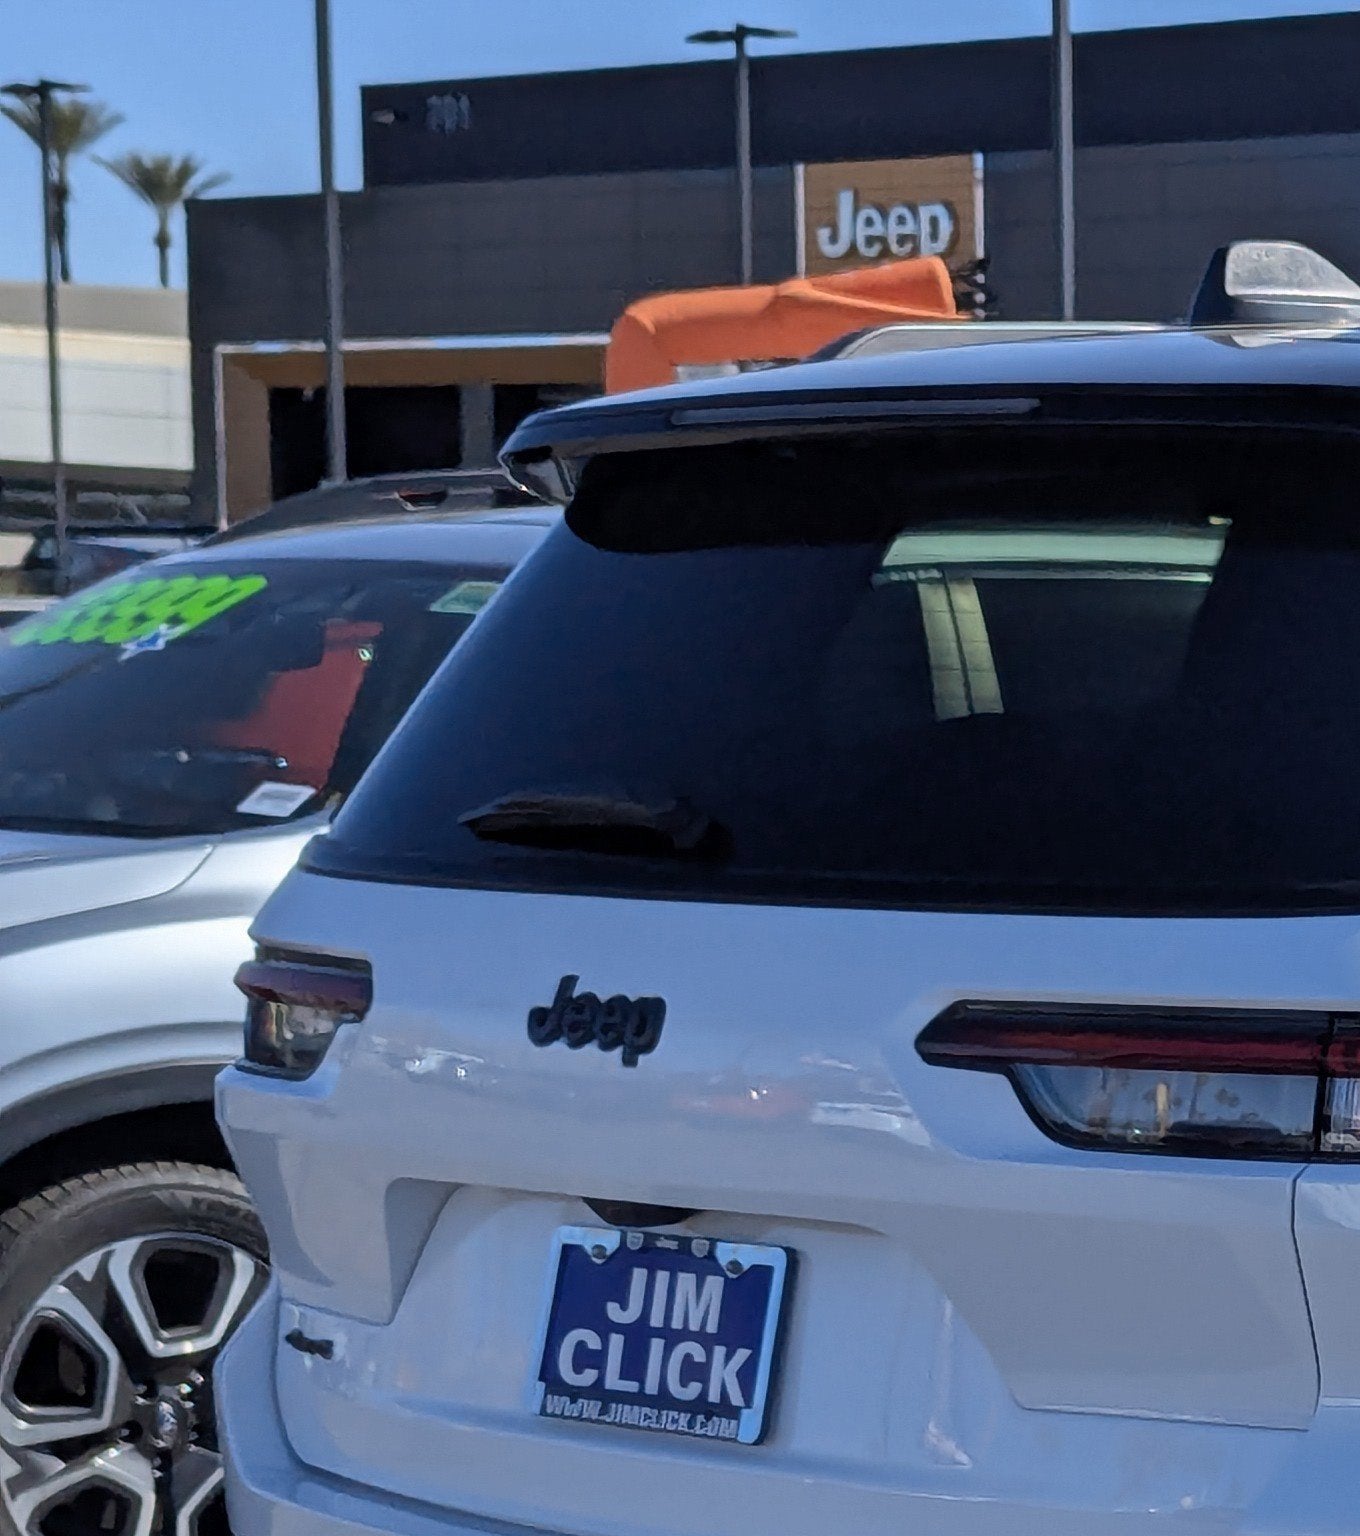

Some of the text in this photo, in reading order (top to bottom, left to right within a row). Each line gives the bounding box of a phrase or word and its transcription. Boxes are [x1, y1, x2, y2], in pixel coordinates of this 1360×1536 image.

[816, 189, 954, 258] Jeep
[527, 974, 667, 1068] Jeep
[606, 1267, 725, 1334] JIM
[557, 1328, 753, 1408] CLICK
